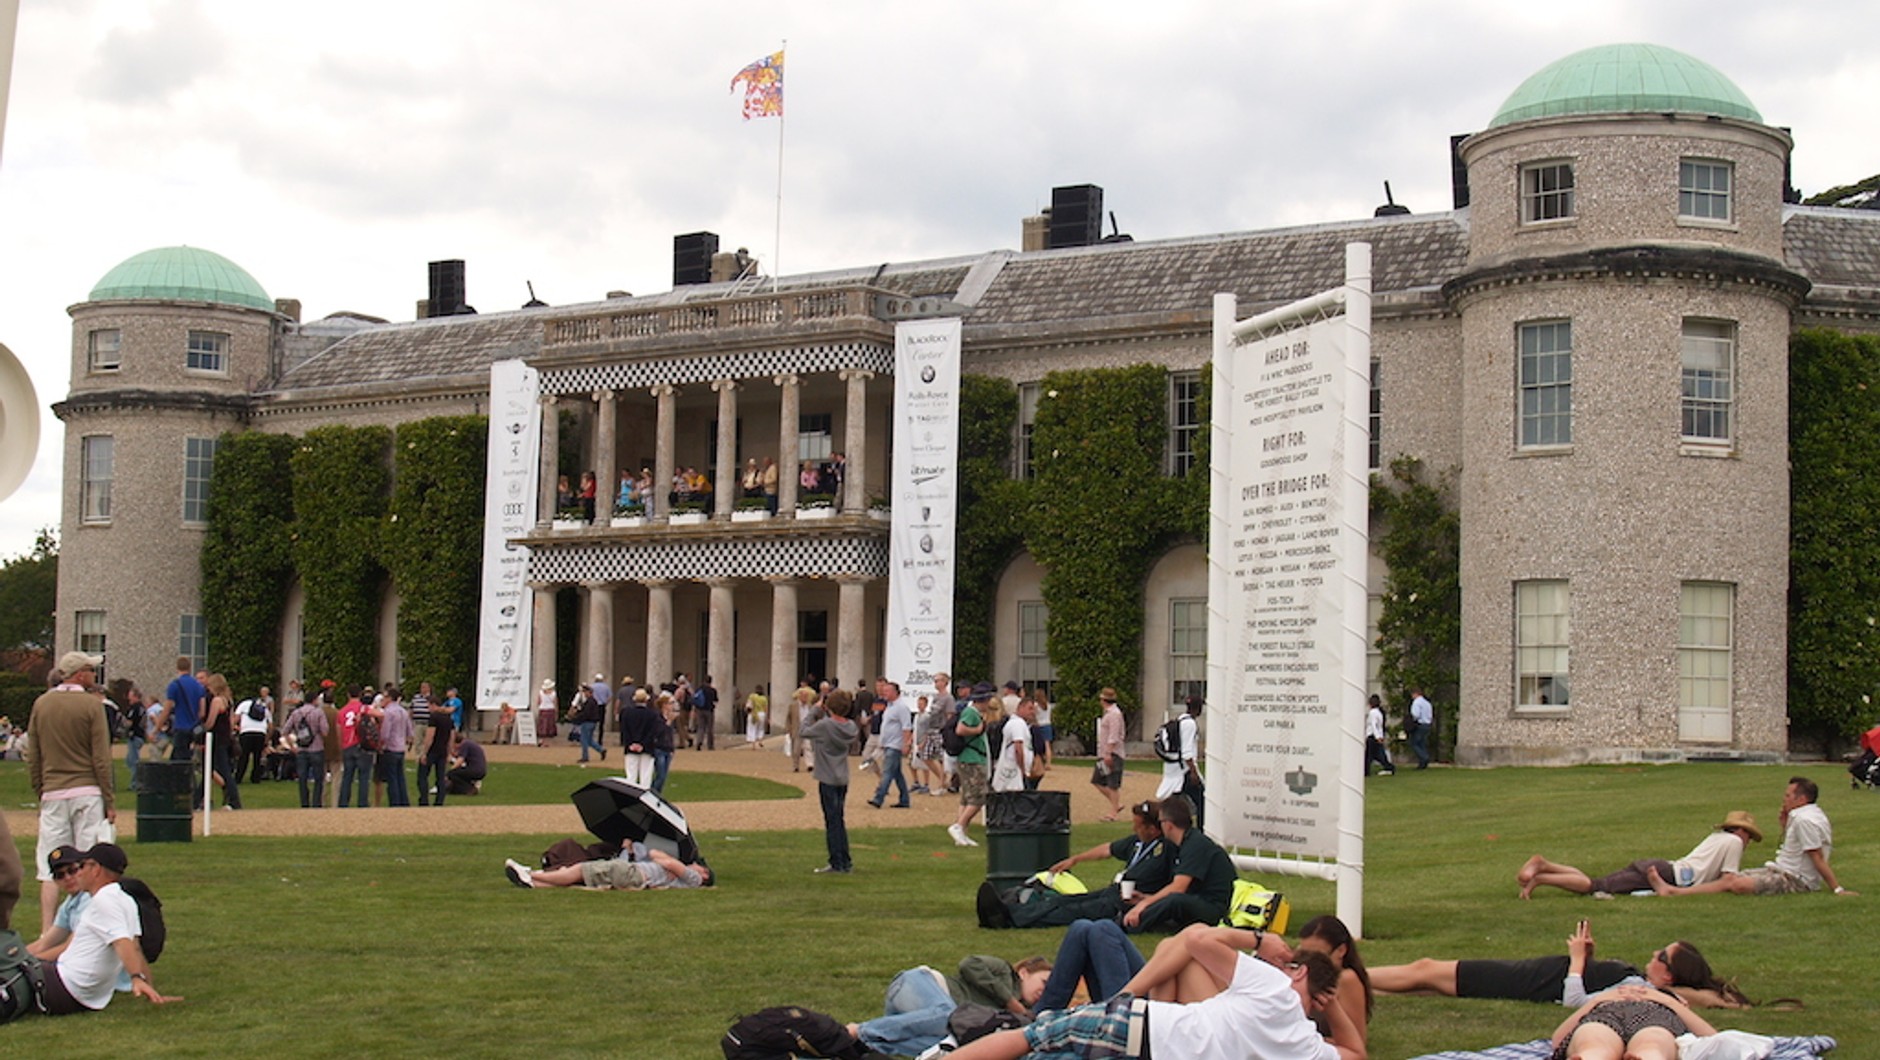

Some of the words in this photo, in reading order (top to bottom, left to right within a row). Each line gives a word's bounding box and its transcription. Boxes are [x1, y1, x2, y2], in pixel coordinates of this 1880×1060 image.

[1265, 346, 1289, 365] AHEAD
[1292, 341, 1310, 358] FOR:
[1263, 434, 1285, 452] RIGHT
[1288, 431, 1306, 447] FOR:
[1242, 484, 1259, 500] OVER
[1261, 481, 1275, 497] THE
[1278, 476, 1307, 494] BRIDGE
[1311, 473, 1330, 491] FOR:
[1302, 529, 1317, 540] LAND
[1319, 528, 1339, 537] ROVER
[1250, 830, 1307, 844] www.goodwood.com
